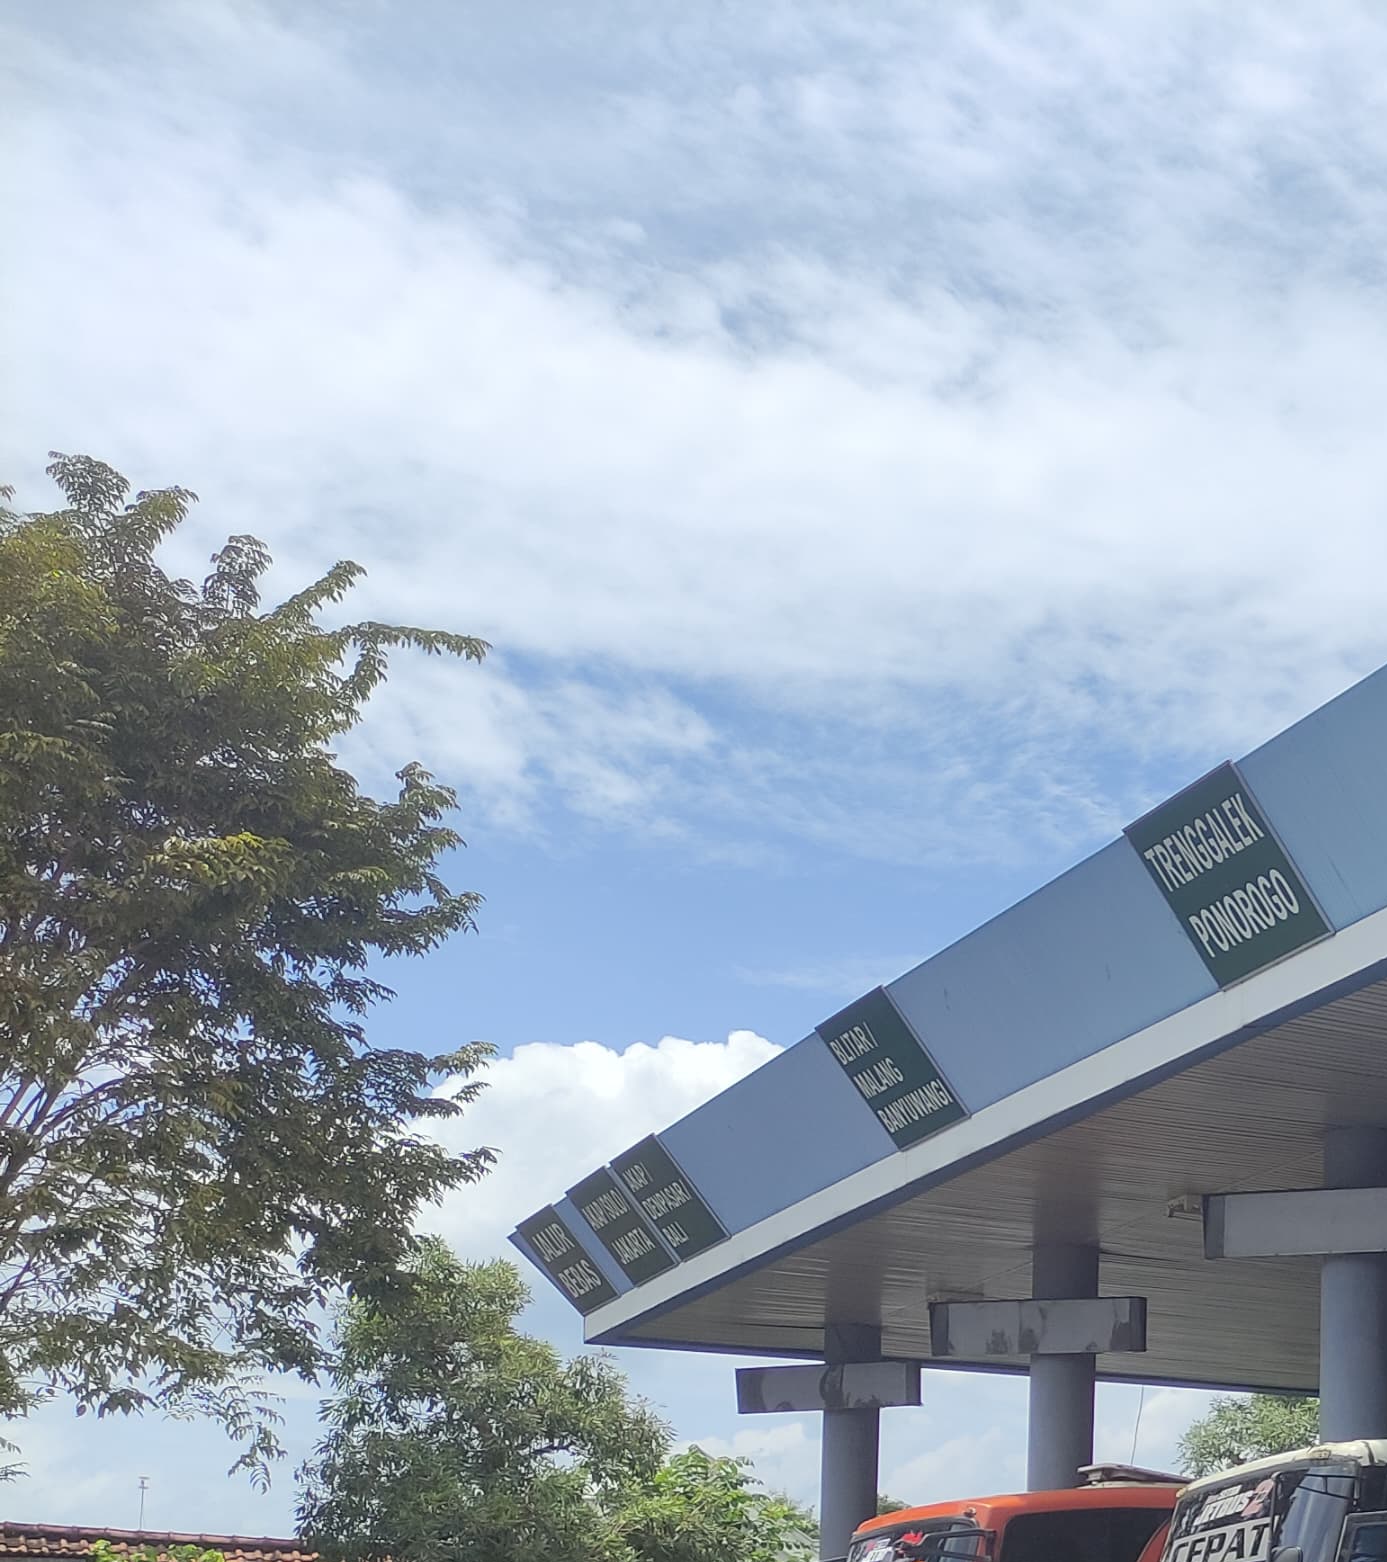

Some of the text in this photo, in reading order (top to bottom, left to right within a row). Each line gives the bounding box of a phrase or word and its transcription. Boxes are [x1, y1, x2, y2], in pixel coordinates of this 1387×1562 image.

[1143, 792, 1265, 893] TRENGGALEK
[1188, 868, 1300, 958] PONOROGO
[853, 1057, 904, 1100] MALANG
[877, 1078, 954, 1134] BANYUWANGI
[532, 1222, 576, 1264] JALUR
[611, 1226, 657, 1266] JAKARTA
[661, 1220, 689, 1249] BALI
[557, 1258, 602, 1299] BEBAS
